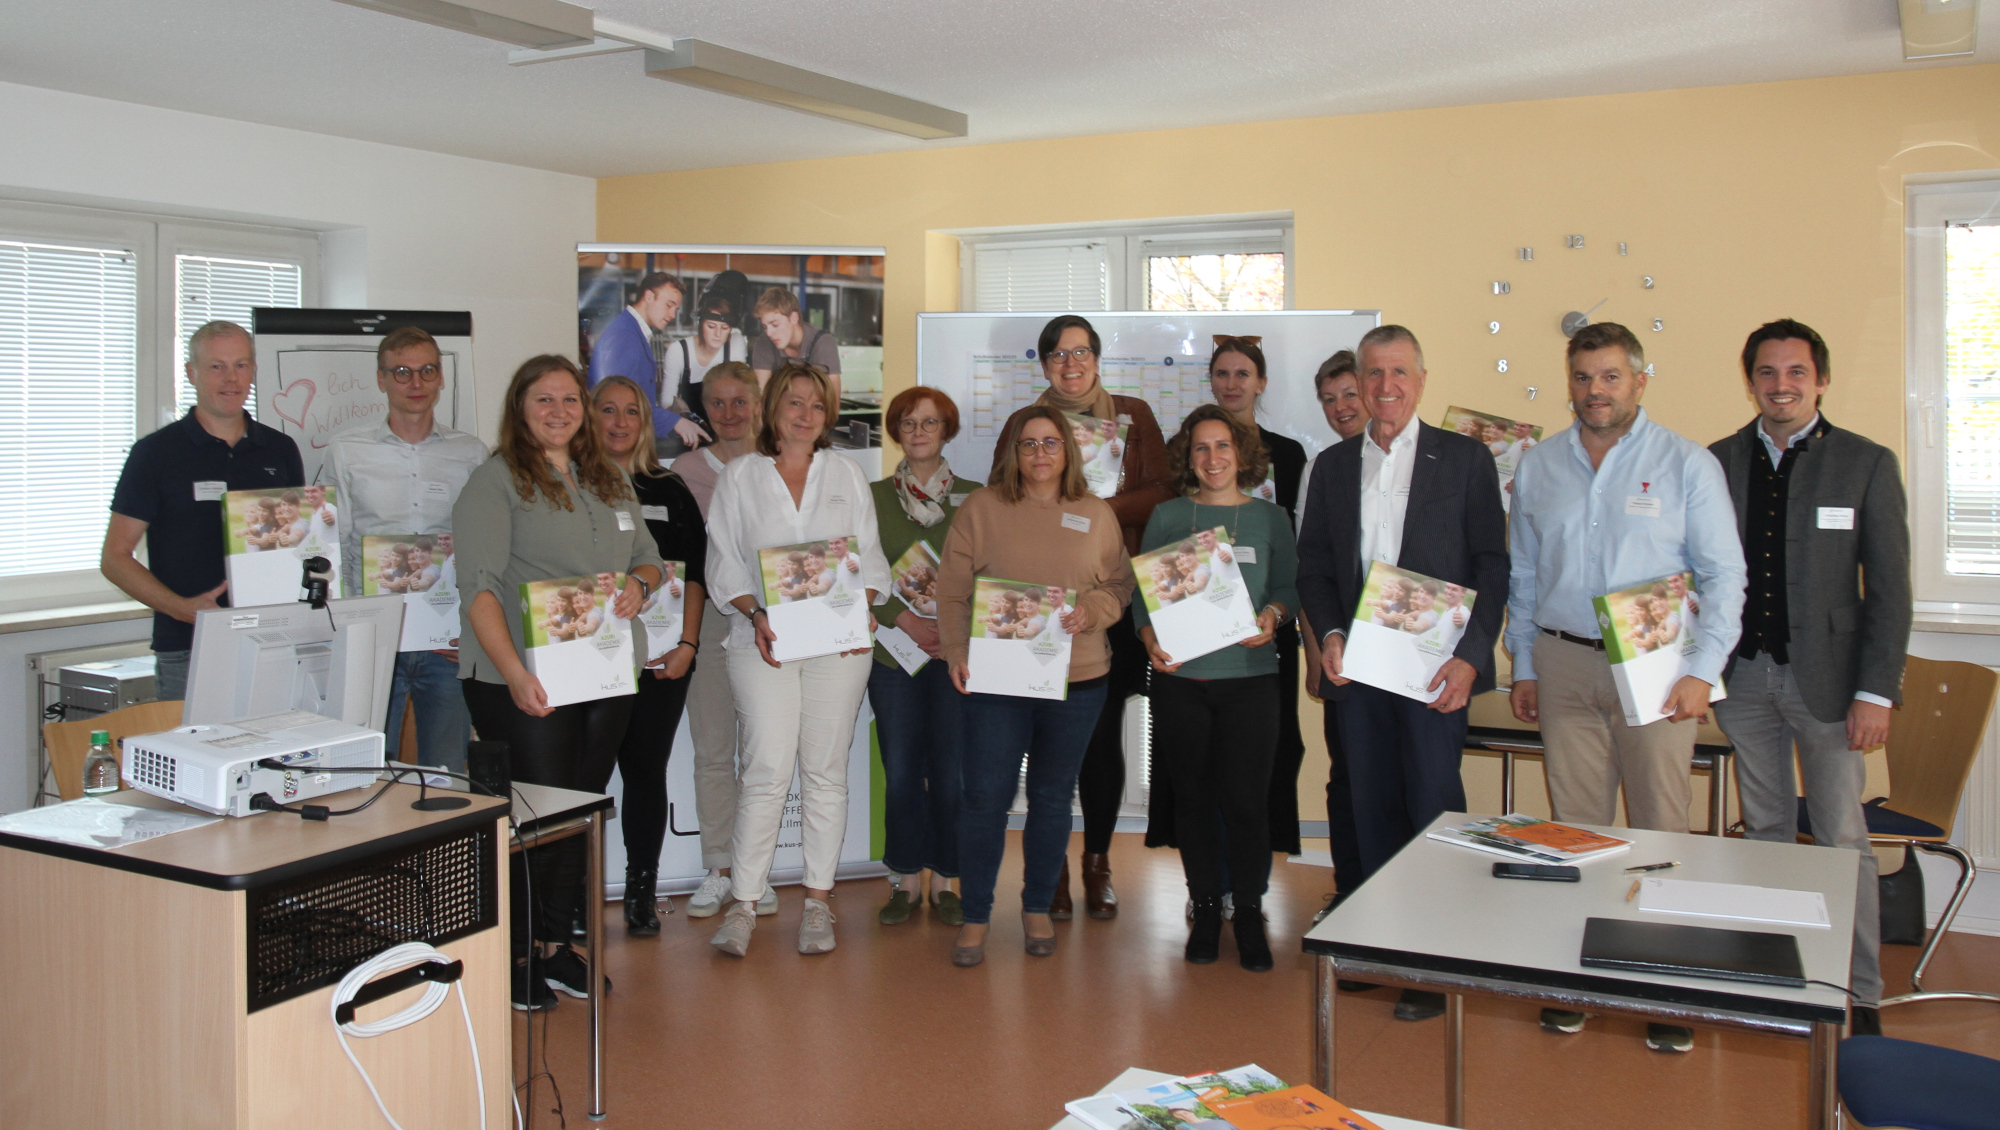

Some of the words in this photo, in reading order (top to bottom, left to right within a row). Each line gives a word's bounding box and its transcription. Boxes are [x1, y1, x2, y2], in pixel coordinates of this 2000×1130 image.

[1566, 235, 1584, 249] 12
[1618, 242, 1628, 256] 1
[1518, 248, 1534, 261] 11
[1492, 282, 1511, 294] 10
[1643, 276, 1655, 290] 2
[1489, 321, 1500, 334] 9
[1652, 318, 1664, 332] 3
[1497, 360, 1508, 373] 8
[1644, 362, 1656, 377] 4
[1527, 386, 1538, 400] 7
